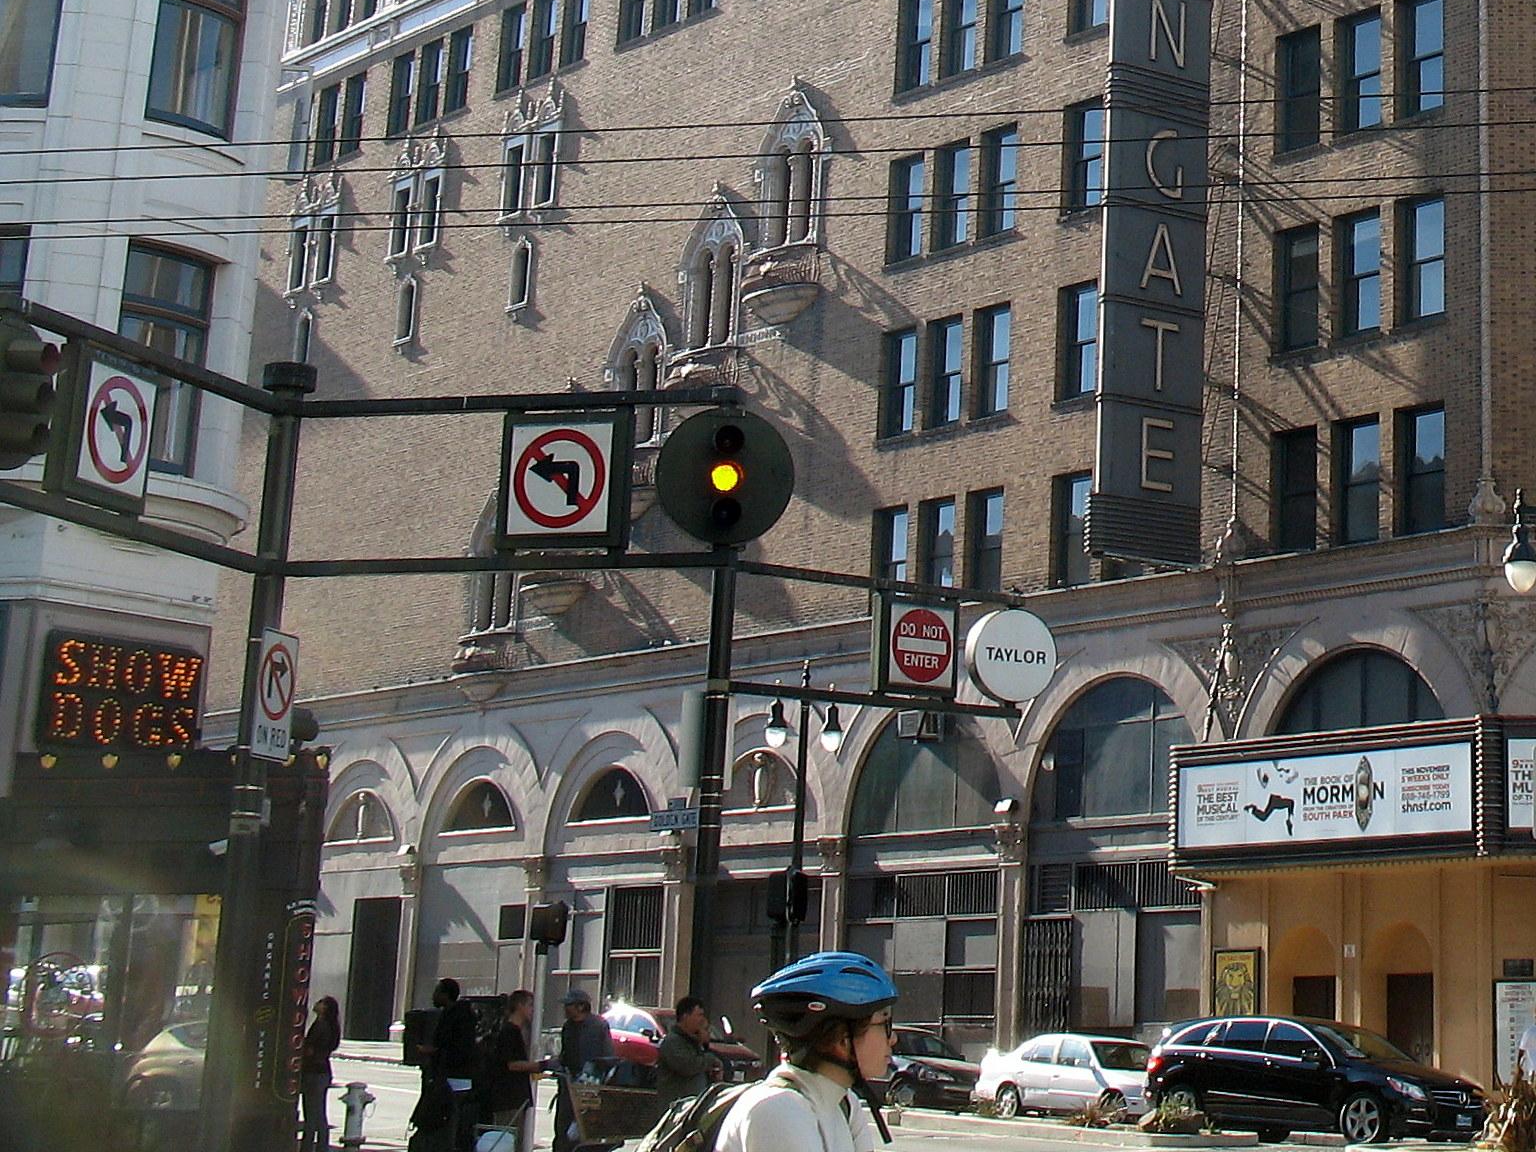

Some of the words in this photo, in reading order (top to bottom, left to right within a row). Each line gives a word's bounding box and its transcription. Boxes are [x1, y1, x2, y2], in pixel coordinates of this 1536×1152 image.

[1139, 129, 1184, 493] GATE
[900, 622, 917, 636] DO
[922, 624, 944, 639] NOT
[903, 653, 940, 670] ENTER
[985, 646, 1046, 665] TAYLOR
[55, 639, 204, 699] SHOW
[53, 691, 194, 748] DOGS
[256, 724, 268, 745] ON
[270, 727, 288, 749] RED
[1416, 764, 1450, 773] NOVEMBER
[1511, 769, 1533, 781] TH
[1303, 777, 1317, 786] THE
[1320, 775, 1342, 786] BOOK
[1343, 774, 1354, 784] OF
[1197, 793, 1215, 806] THE
[1216, 791, 1239, 804] BEST
[1401, 799, 1452, 814] shnsf.com
[1197, 802, 1239, 816] MUSICAL
[1302, 811, 1331, 822] SOUTH
[1332, 810, 1354, 820] PARK
[262, 932, 274, 1000] ORGANIC
